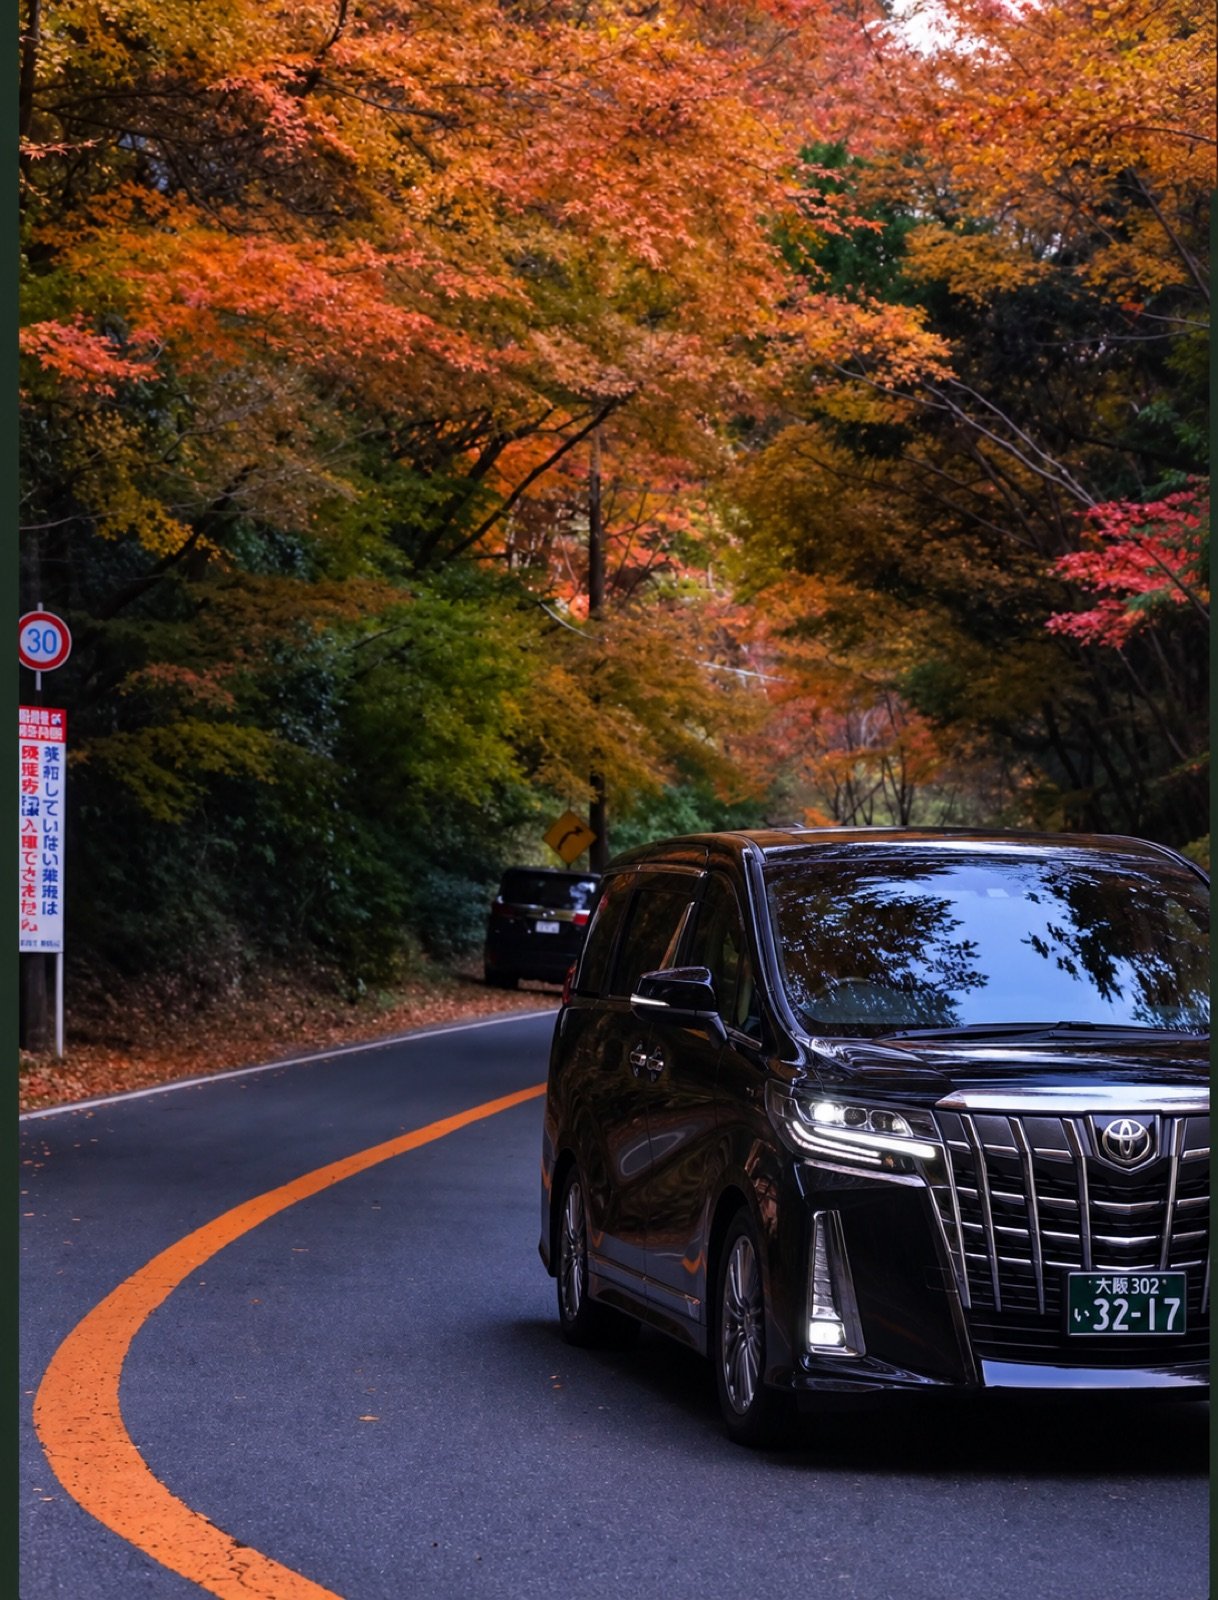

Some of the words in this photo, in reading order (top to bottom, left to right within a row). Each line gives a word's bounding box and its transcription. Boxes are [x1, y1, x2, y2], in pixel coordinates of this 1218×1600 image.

[27, 628, 57, 654] 30
[1131, 1278, 1159, 1294] 302
[1093, 1298, 1180, 1330] 32-17
